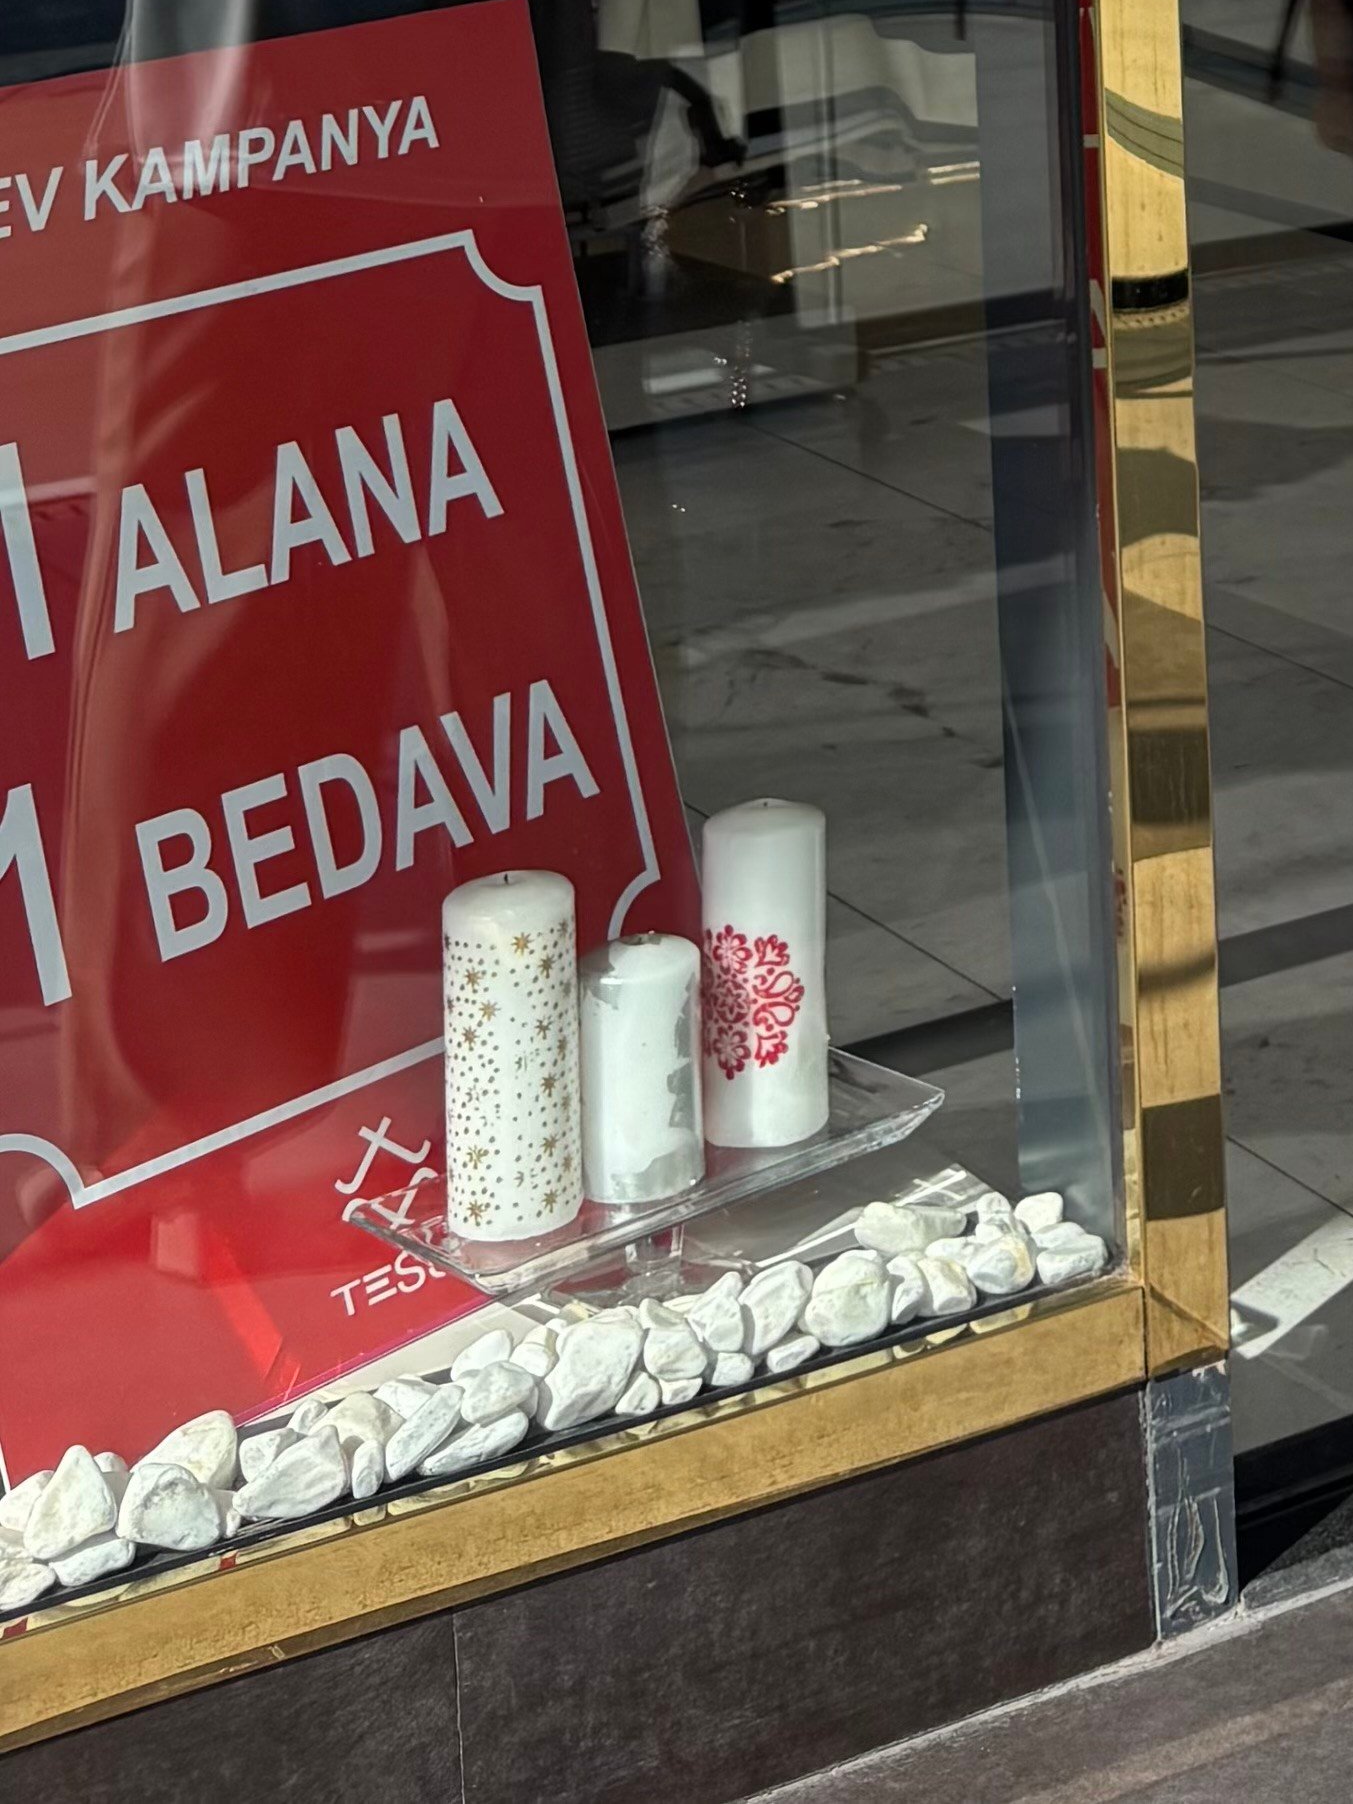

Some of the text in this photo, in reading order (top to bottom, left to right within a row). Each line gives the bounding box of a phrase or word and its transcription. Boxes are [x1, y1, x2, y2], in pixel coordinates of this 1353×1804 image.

[84, 95, 440, 221] KAMPANYA
[113, 398, 505, 634] ALANA
[0, 679, 600, 1007] 1 BEDAVA
[330, 1250, 446, 1316] TES
